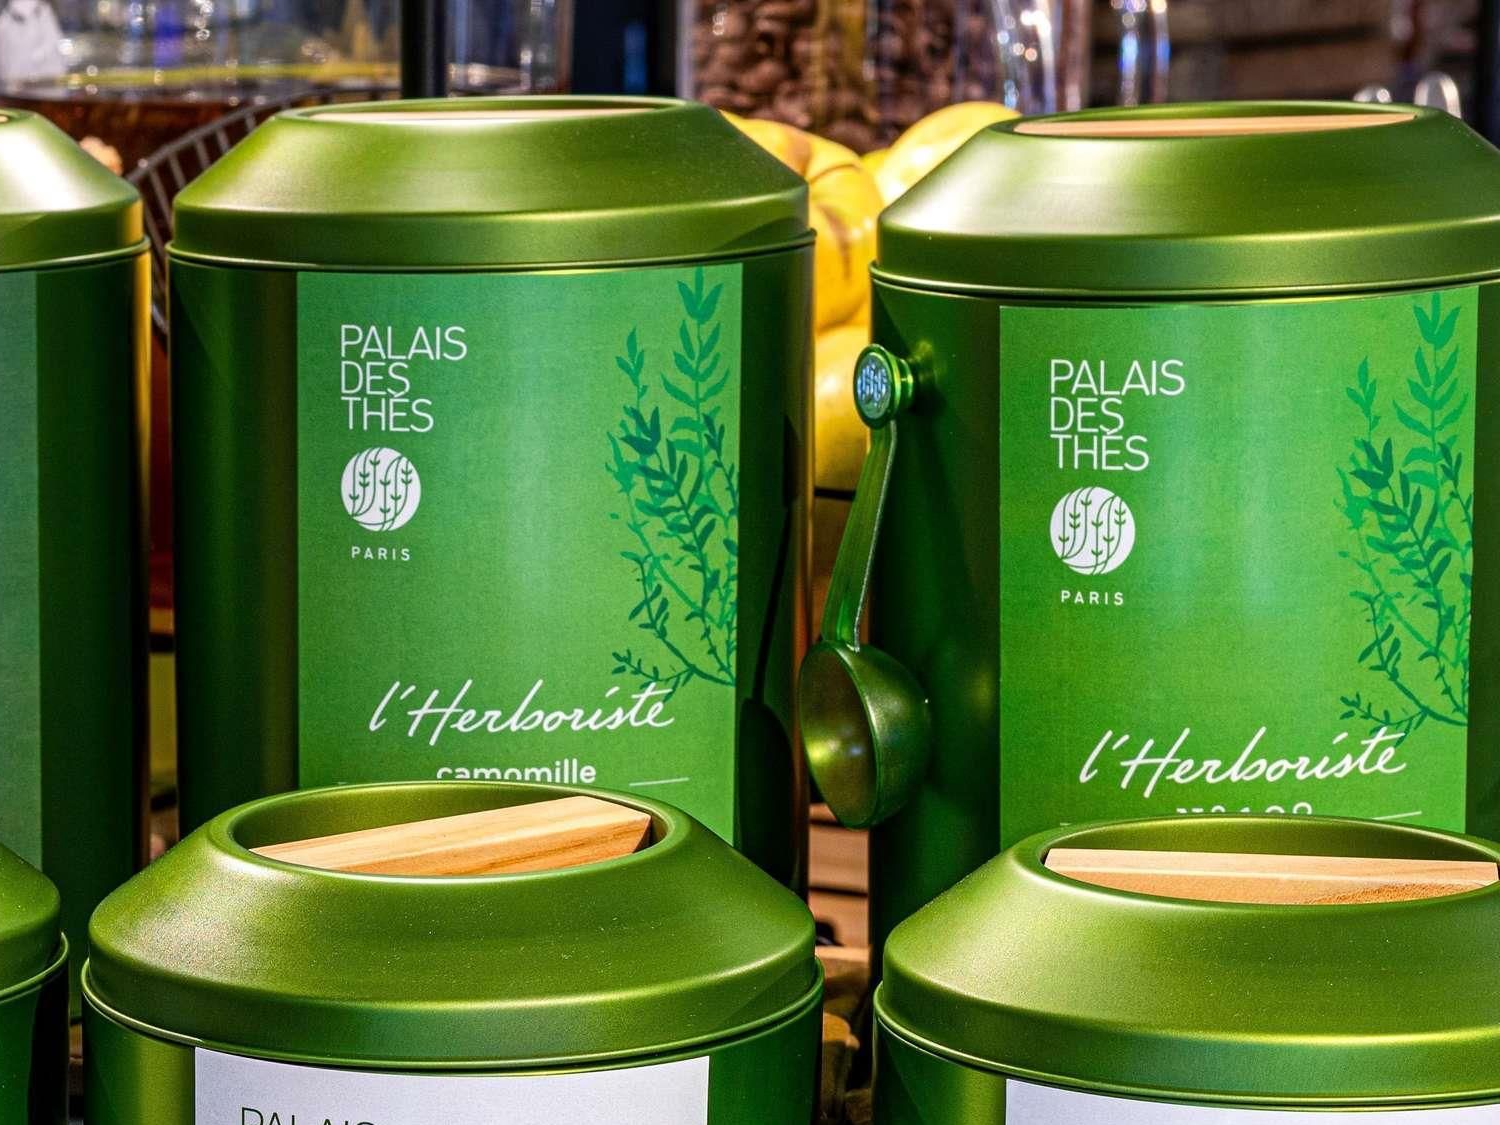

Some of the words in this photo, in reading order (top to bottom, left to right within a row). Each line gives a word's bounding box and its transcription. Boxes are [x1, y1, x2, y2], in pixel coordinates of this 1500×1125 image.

[341, 324, 467, 362] PALAIS
[341, 361, 410, 397] DES
[1050, 359, 1185, 398] PALAIS
[341, 391, 434, 433] THÉS
[1050, 398, 1124, 435] DES
[1050, 429, 1150, 472] THÉS
[351, 545, 411, 562] PARIS
[1061, 589, 1124, 606] PARIS
